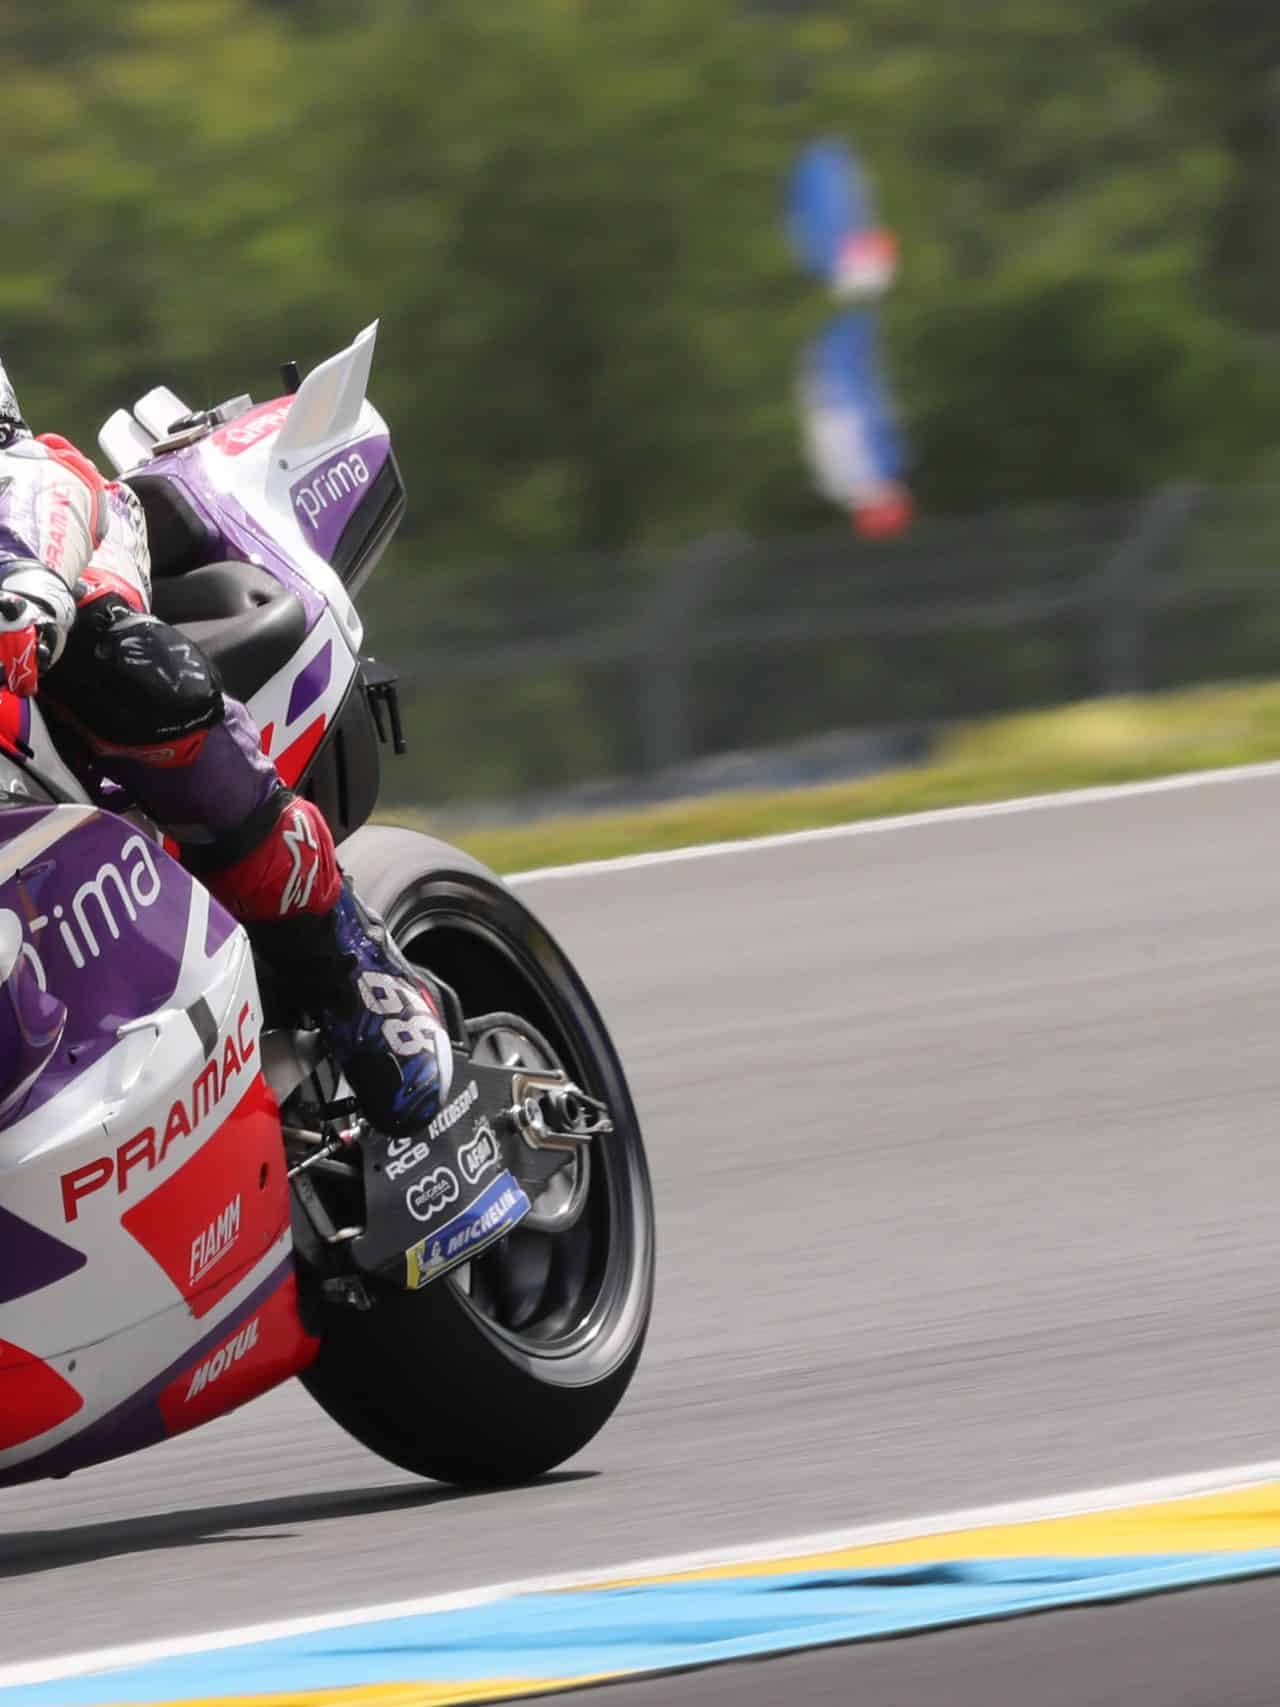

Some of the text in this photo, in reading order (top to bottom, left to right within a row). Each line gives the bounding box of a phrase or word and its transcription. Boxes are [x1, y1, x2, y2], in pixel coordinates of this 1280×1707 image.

[295, 452, 370, 529] prima
[57, 1002, 257, 1223] PRAMAC
[385, 1142, 430, 1181] RCB
[189, 1193, 241, 1273] FIAMM
[447, 1188, 517, 1255] MICHELIN
[184, 1317, 260, 1403] MOTUL
